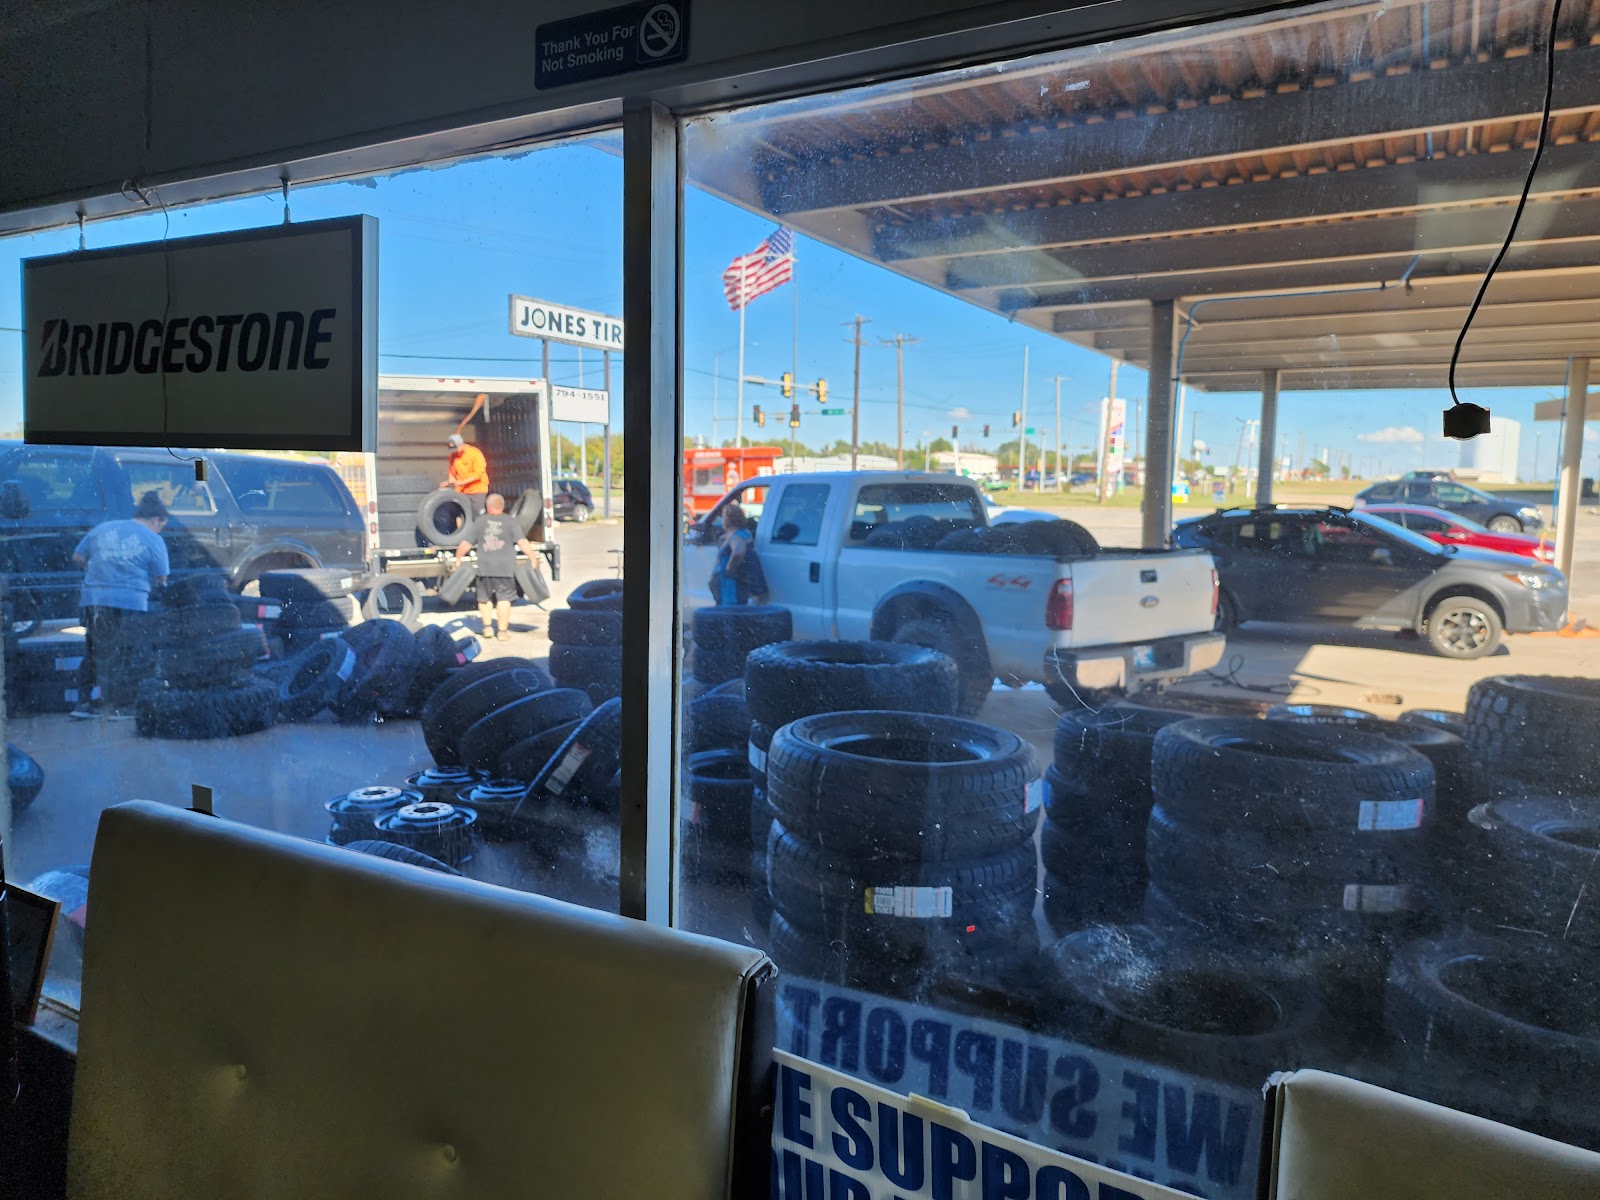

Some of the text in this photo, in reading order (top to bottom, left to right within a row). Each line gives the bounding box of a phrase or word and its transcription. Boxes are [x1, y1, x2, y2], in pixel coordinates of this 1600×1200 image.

[542, 25, 637, 56] Thank You For
[542, 45, 625, 73] Not Smoking
[520, 305, 587, 338] JONES
[37, 308, 337, 377] BRIDGESTONE
[555, 388, 605, 401] 794-1551
[771, 1061, 814, 1150] E
[831, 1086, 1145, 1200] SUPP
